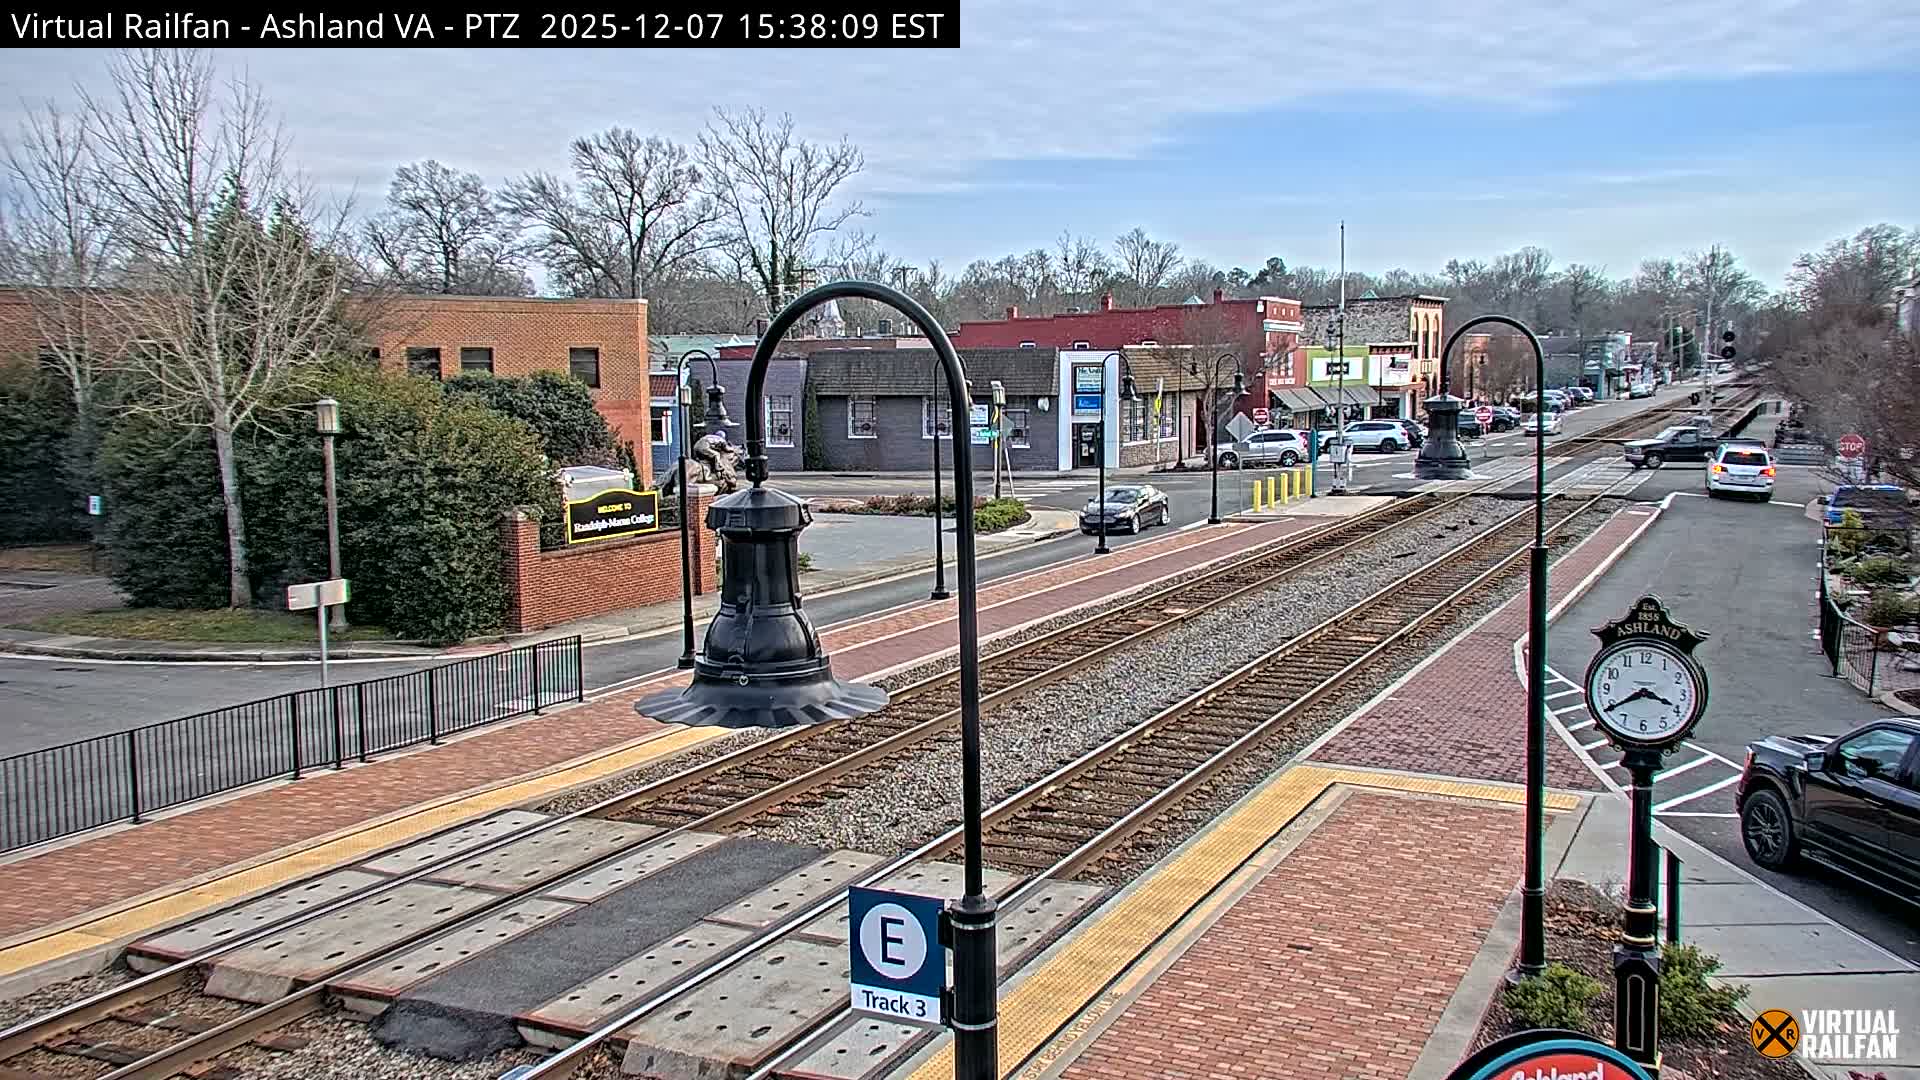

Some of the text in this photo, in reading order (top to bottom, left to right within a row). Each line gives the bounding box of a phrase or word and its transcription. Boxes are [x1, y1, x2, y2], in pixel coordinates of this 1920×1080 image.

[1840, 442, 1863, 452] STOP
[631, 513, 655, 525] College
[1617, 622, 1681, 640] ASHLAND
[1623, 655, 1632, 668] 11
[1640, 653, 1652, 665] 12
[1662, 659, 1667, 671] 1
[1608, 667, 1620, 680] 10
[1675, 672, 1682, 685] 2
[1603, 683, 1611, 695] 9
[1680, 689, 1687, 701] 3
[1673, 705, 1681, 717] 4
[1620, 714, 1628, 726] 7
[1640, 720, 1647, 731] 6
[1659, 717, 1668, 729] 5
[880, 916, 905, 966] E
[862, 990, 927, 1017] Track 3
